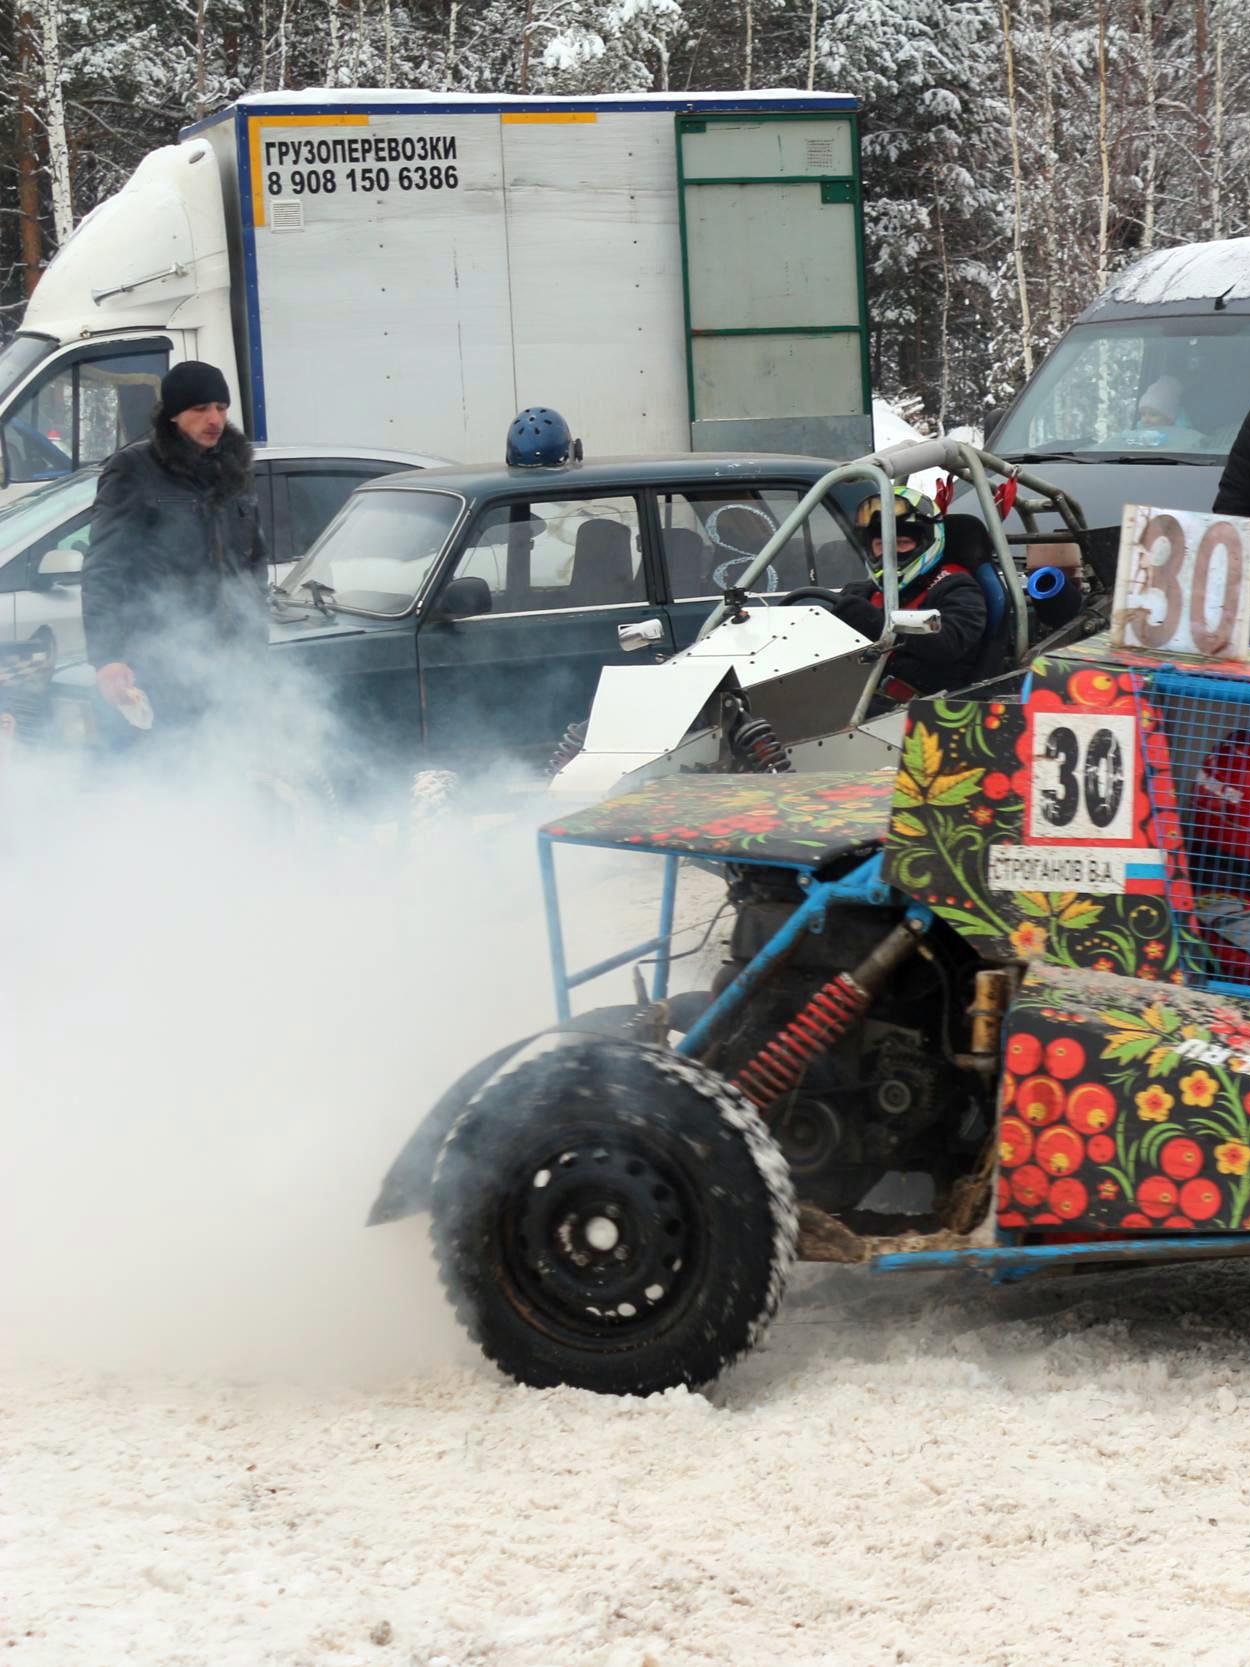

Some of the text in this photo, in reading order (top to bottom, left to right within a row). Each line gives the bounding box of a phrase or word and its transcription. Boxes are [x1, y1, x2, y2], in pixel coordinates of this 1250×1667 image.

[264, 135, 458, 166] ГРУЗОПЕРЕВОЗКИ
[267, 164, 459, 196] 8 908 150 6386
[1131, 513, 1244, 655] 30
[1041, 726, 1125, 828] 30
